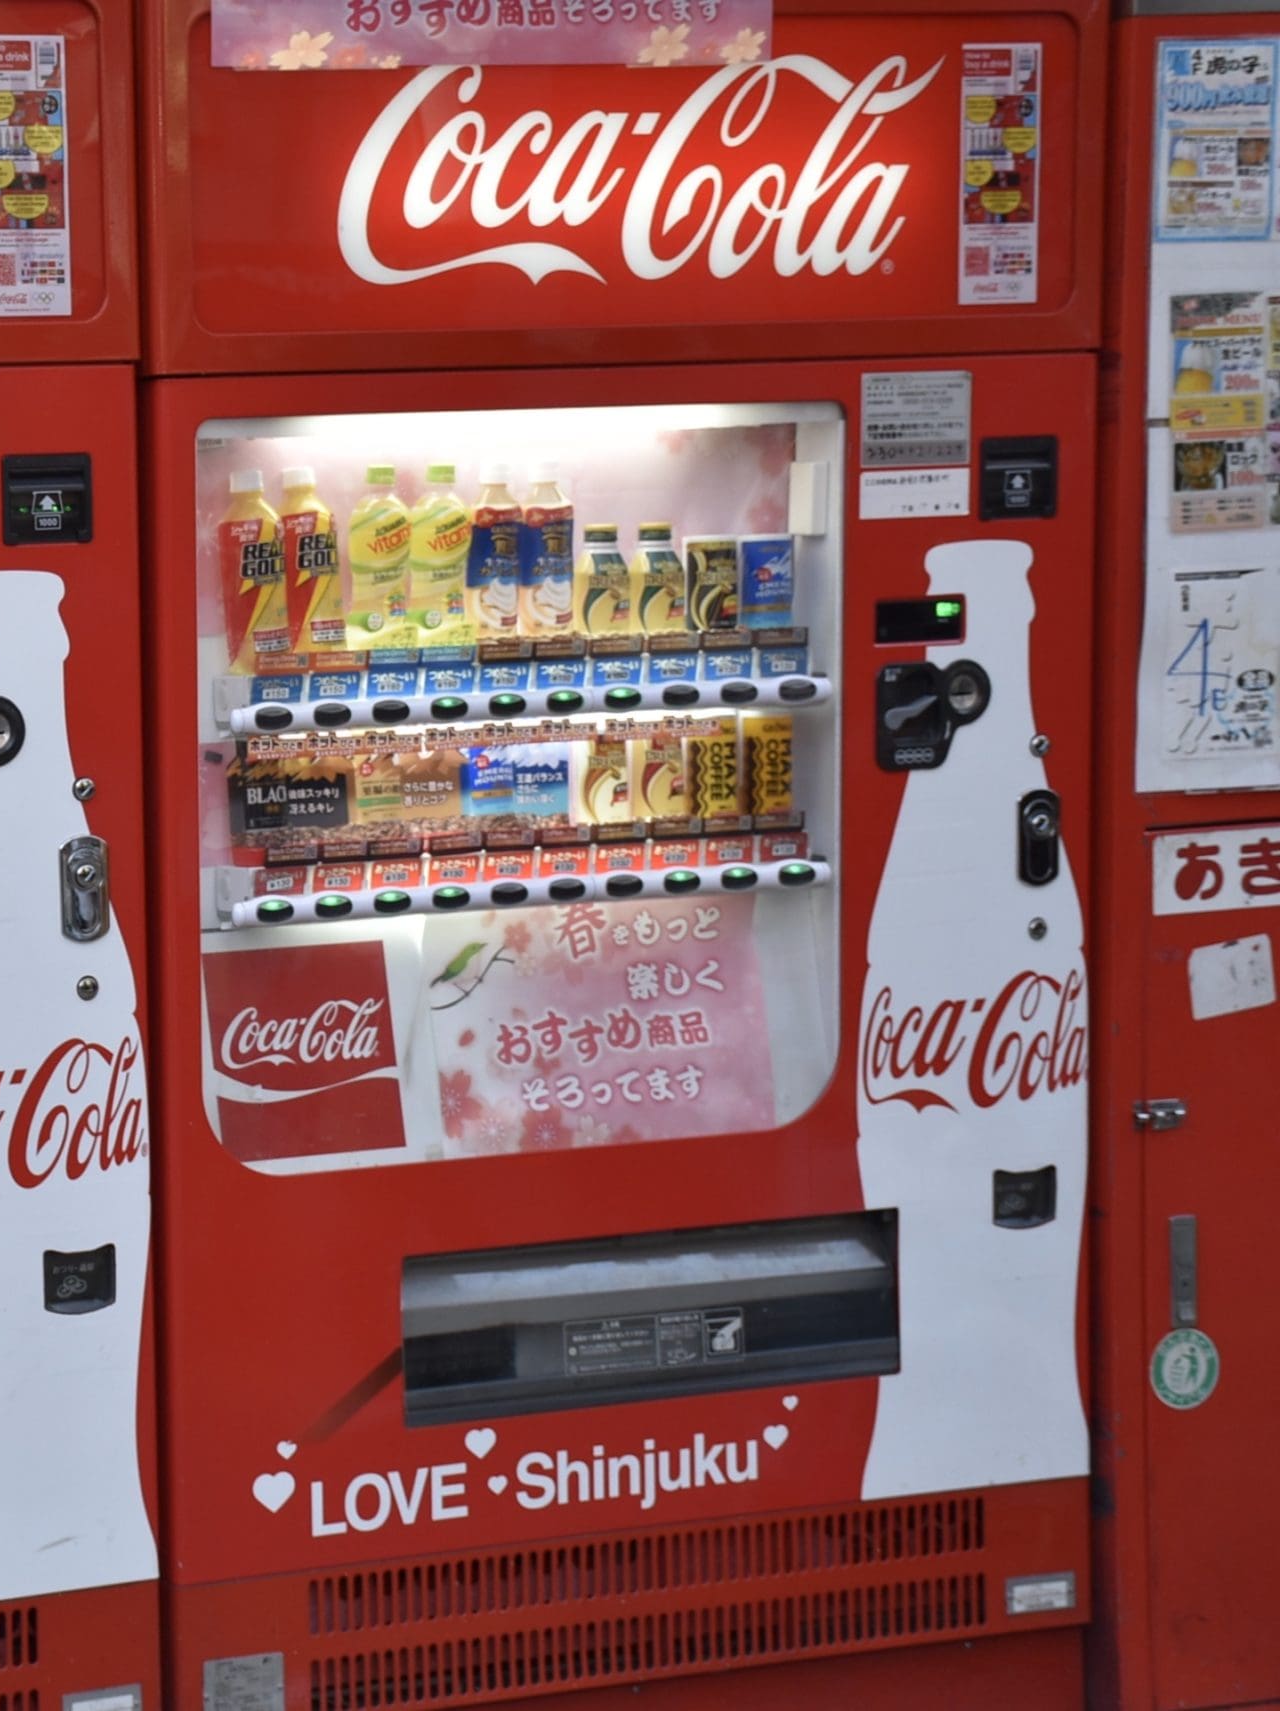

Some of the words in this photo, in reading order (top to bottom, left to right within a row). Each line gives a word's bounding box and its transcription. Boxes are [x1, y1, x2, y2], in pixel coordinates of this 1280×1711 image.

[337, 54, 947, 286] Coca-Cola
[38, 518, 58, 527] 1000
[557, 902, 721, 960] 春をもっと
[627, 961, 724, 1000] 楽しく
[221, 996, 384, 1069] Coca-Cola
[496, 1011, 710, 1066] おすすめ商品
[863, 968, 1088, 1115] Coca-Cola
[522, 1064, 705, 1113] そろってます
[310, 1463, 469, 1537] LOVE
[515, 1432, 760, 1510] Shinjuku
